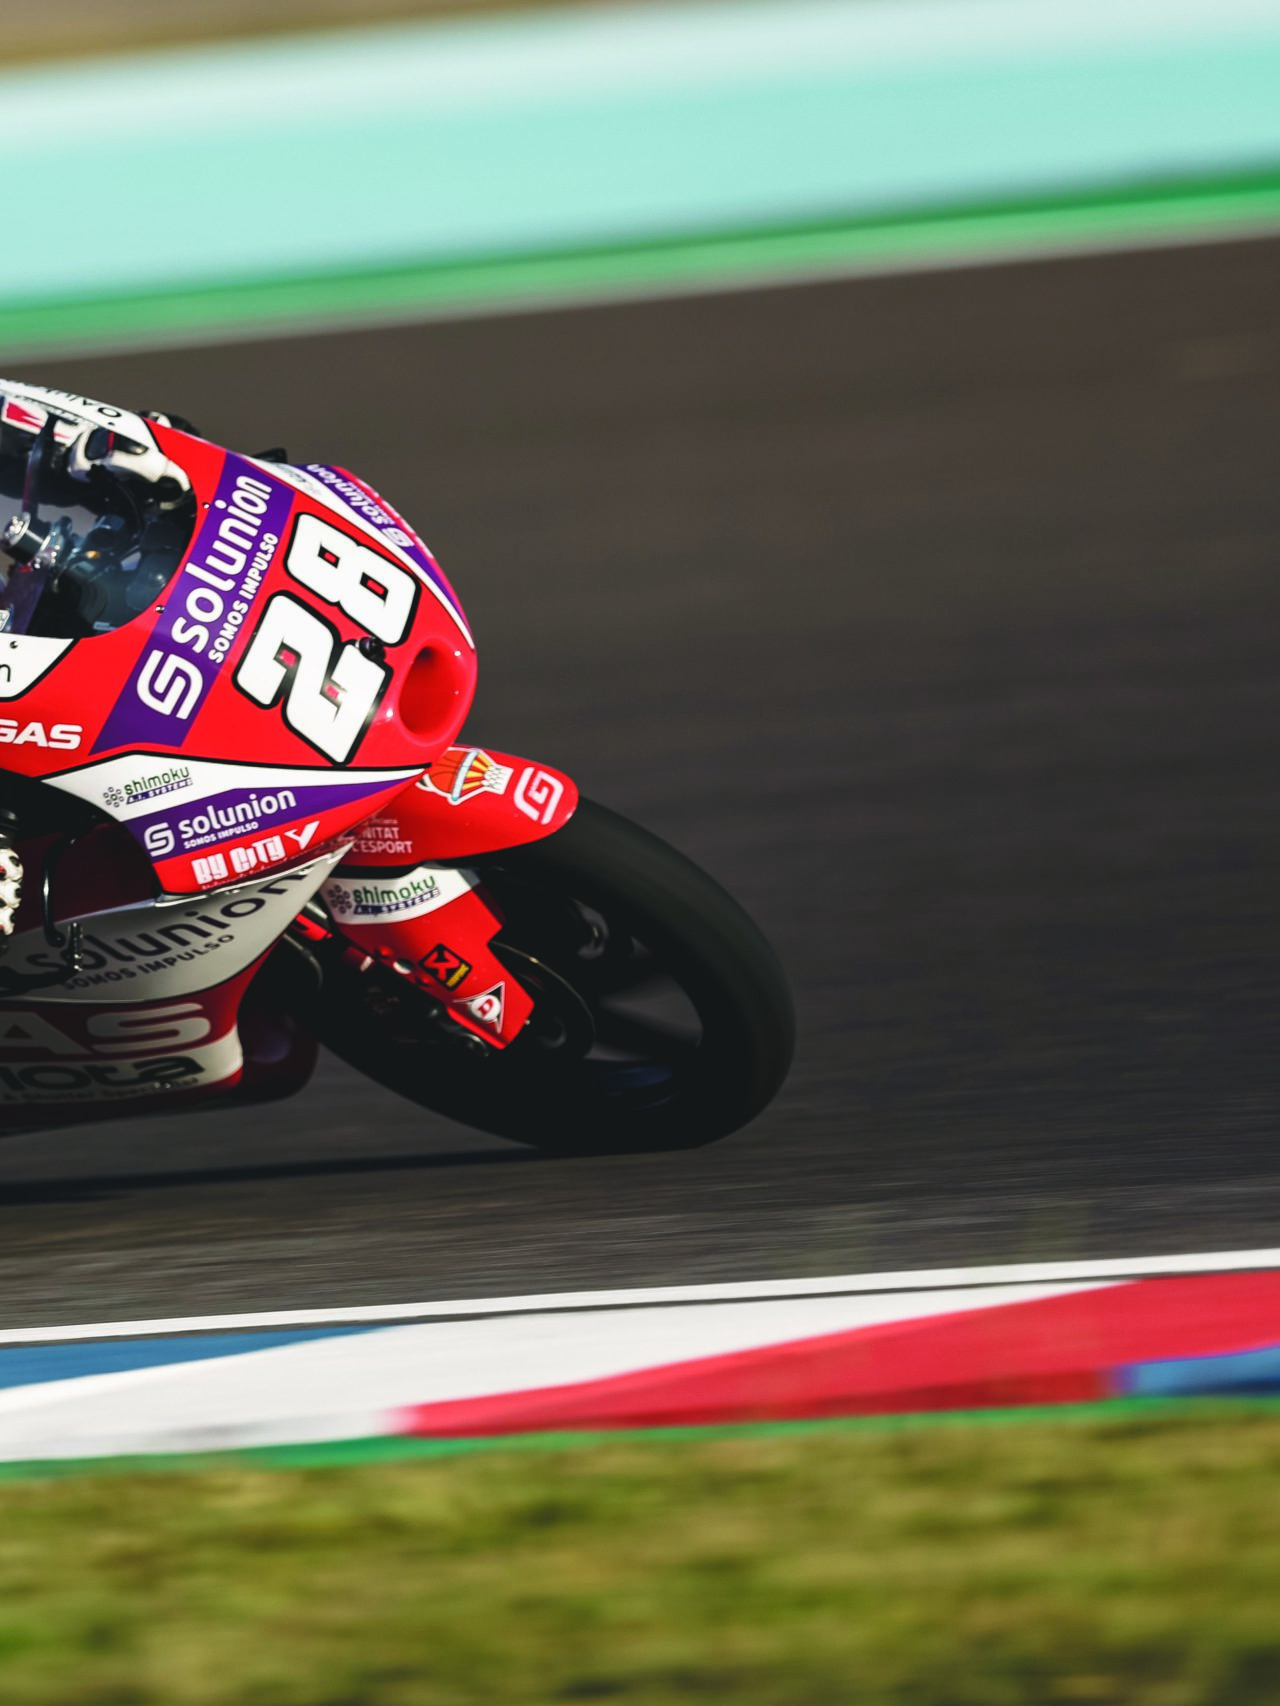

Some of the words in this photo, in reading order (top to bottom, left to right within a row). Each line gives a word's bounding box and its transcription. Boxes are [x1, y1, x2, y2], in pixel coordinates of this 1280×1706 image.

[171, 475, 272, 654] solunion
[208, 600, 249, 664] SOMOS
[238, 532, 279, 600] IMPULSO
[235, 513, 418, 763] 28
[124, 766, 190, 796] shimoku
[178, 789, 297, 839] solunion
[183, 833, 217, 849] SOMOS
[218, 821, 259, 839] IMPULSO
[352, 876, 436, 904] shimoku
[140, 934, 236, 975] IMPULSO
